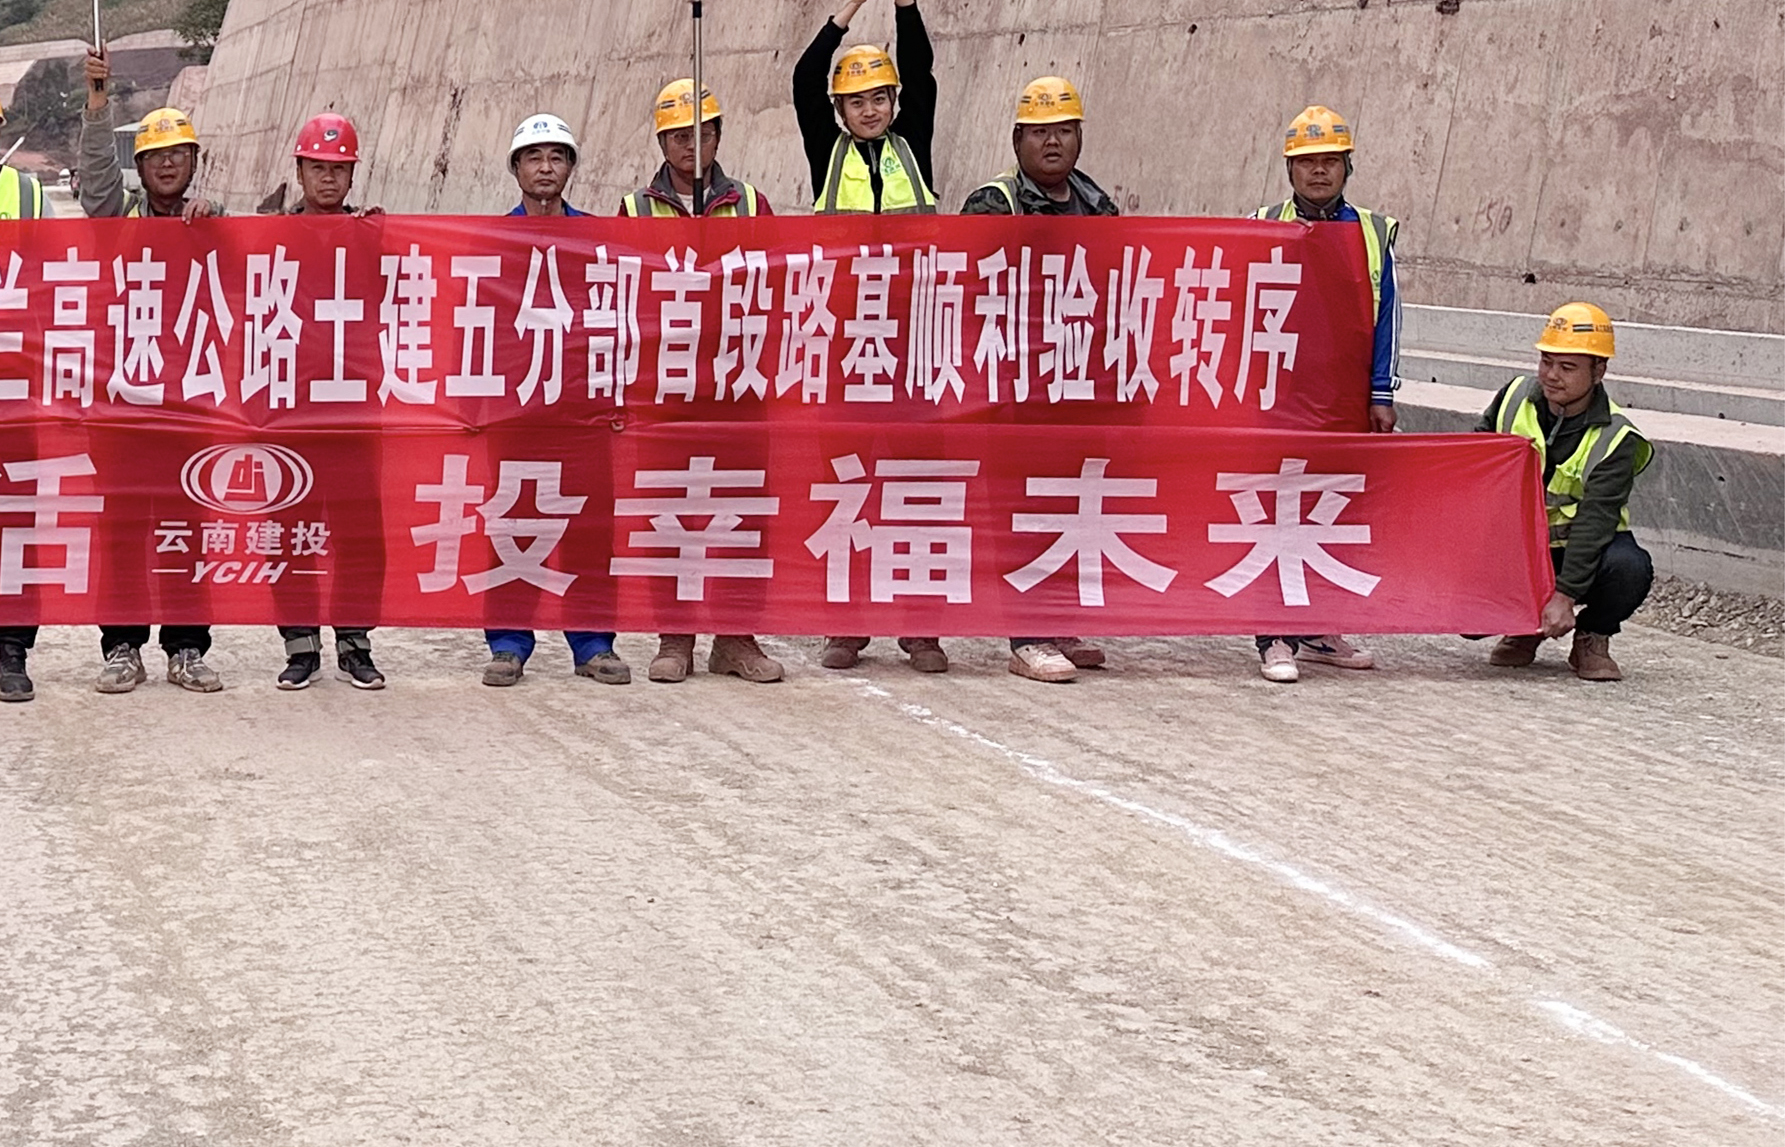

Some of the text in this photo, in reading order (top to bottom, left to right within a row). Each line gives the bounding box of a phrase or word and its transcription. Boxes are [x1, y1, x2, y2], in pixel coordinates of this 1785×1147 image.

[154, 519, 331, 556] 云南建投
[410, 453, 1382, 607] 投幸福未来
[191, 561, 288, 584] YCIH
